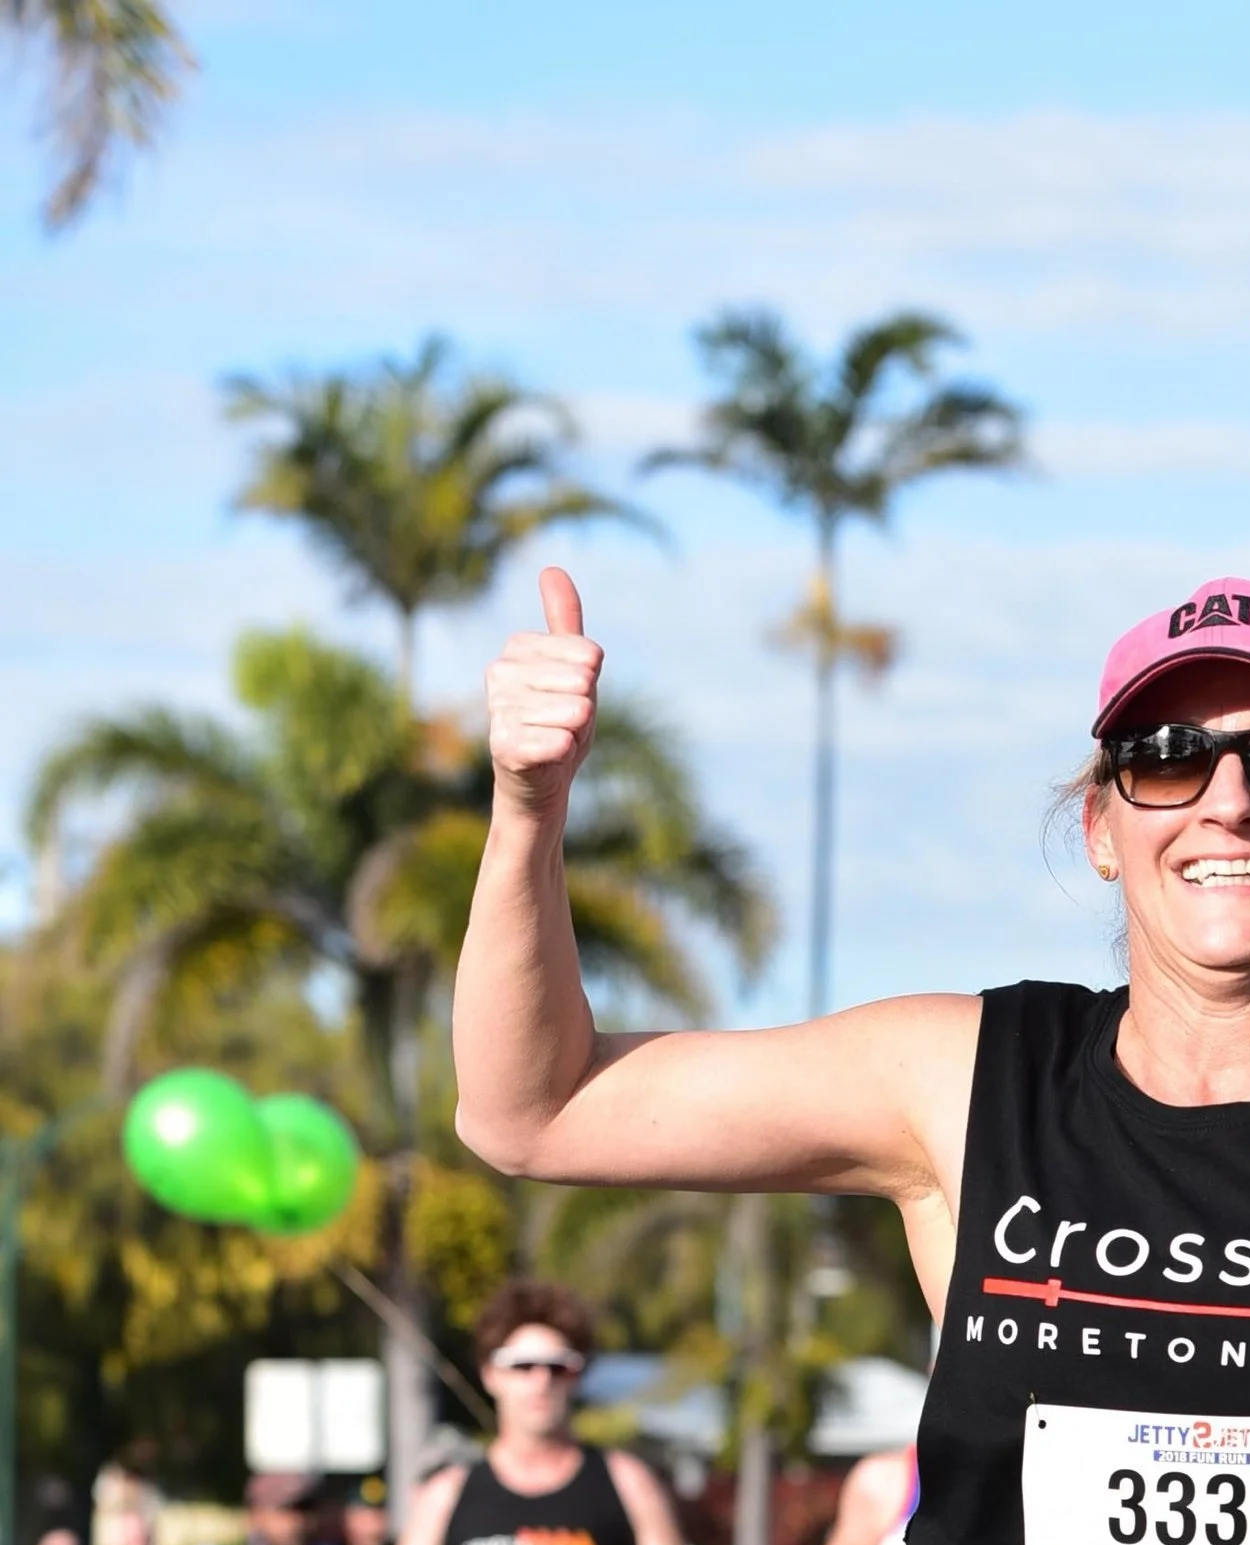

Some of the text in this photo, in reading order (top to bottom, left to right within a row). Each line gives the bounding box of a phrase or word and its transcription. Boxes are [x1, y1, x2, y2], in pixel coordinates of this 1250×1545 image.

[966, 1314, 1247, 1368] MORETON
[1159, 1450, 1247, 1465] 2018 FUN RUN
